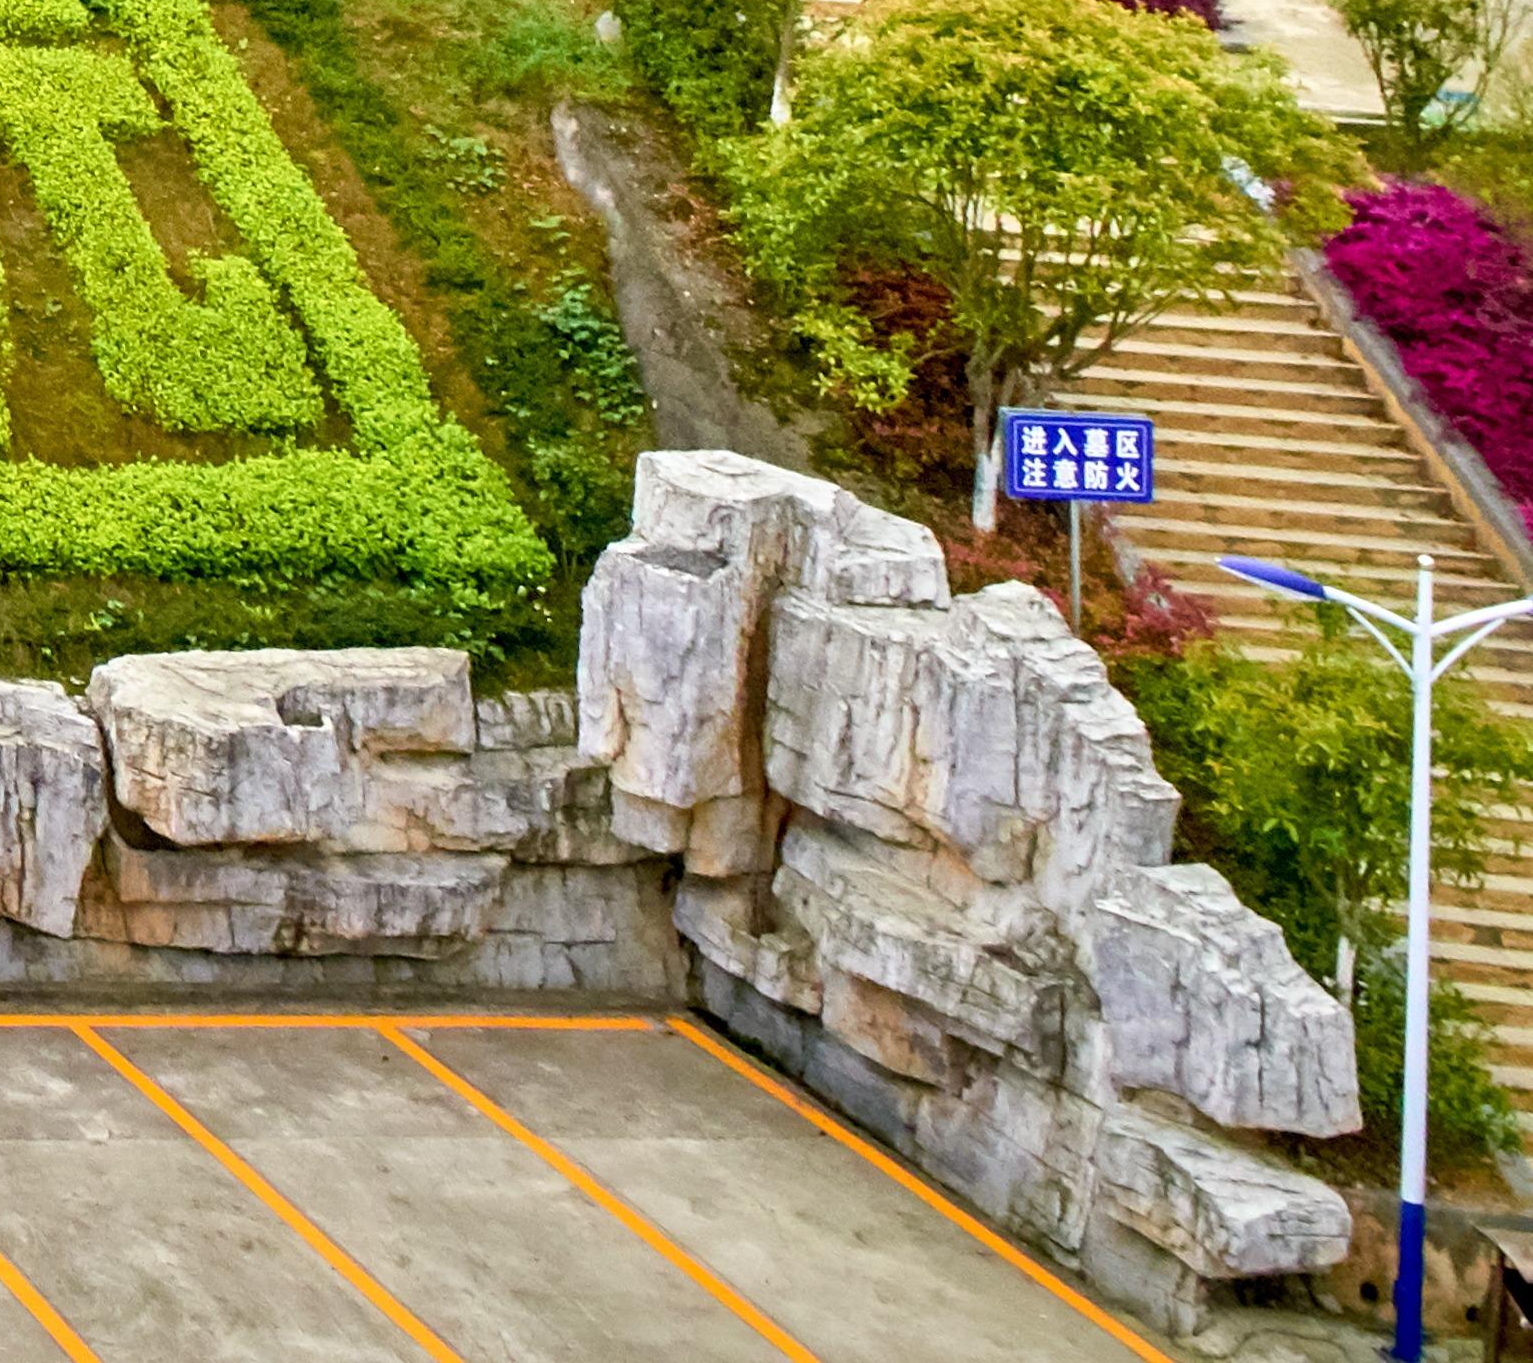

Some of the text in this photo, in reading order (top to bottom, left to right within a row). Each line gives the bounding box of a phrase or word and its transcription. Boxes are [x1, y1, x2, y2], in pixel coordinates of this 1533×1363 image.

[1021, 425, 1141, 459] 进入墓区
[1022, 457, 1141, 492] 注意防火
